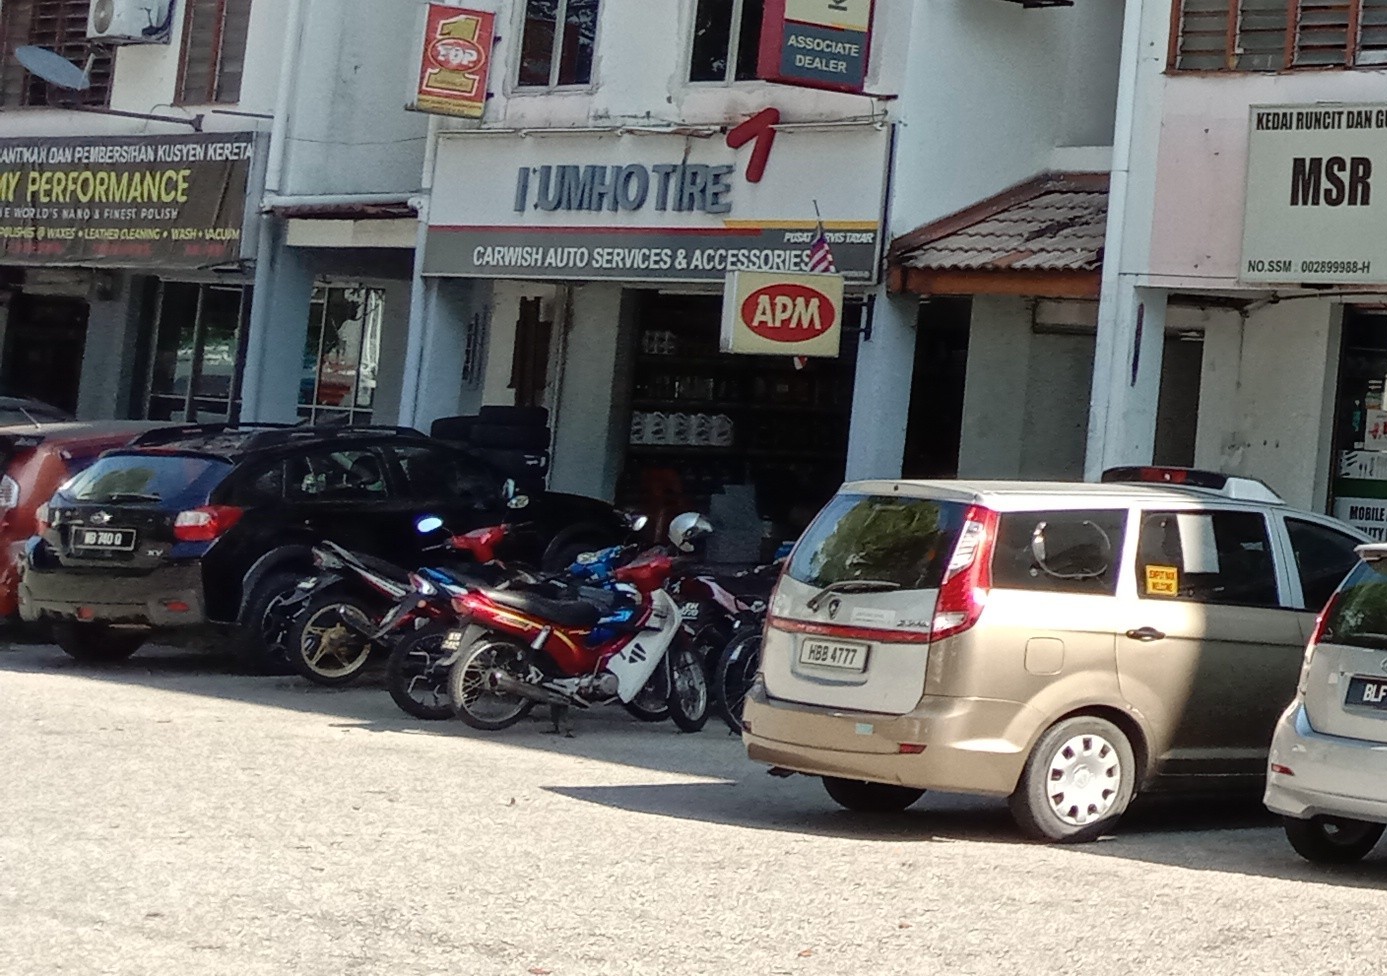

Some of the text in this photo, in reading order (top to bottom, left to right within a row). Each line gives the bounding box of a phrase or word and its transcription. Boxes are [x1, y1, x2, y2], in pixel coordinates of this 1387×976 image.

[787, 34, 859, 56] ASSOCIATE
[795, 54, 847, 74] DEALER
[1256, 111, 1294, 130] KEDAI
[1296, 110, 1345, 130] RUNCIT
[1346, 110, 1373, 129] DAN
[74, 145, 156, 164] PEMBERSIHAN
[157, 143, 204, 162] KUSYEN
[206, 142, 254, 161] KERETA
[26, 169, 192, 203] PERFORMANCE
[652, 163, 735, 214] TIRE
[1289, 156, 1373, 207] MSR
[104, 207, 136, 219] FINEST
[141, 207, 179, 219] POLISH
[84, 229, 119, 240] LEATHER
[473, 246, 811, 272] CARWISH AUTO SERVICES & ACCESSORIES
[1248, 260, 1371, 274] NO.SSM 002899988-H
[752, 295, 822, 330] APM
[1349, 506, 1385, 521] MOBILE
[808, 644, 857, 665] HBB 4777
